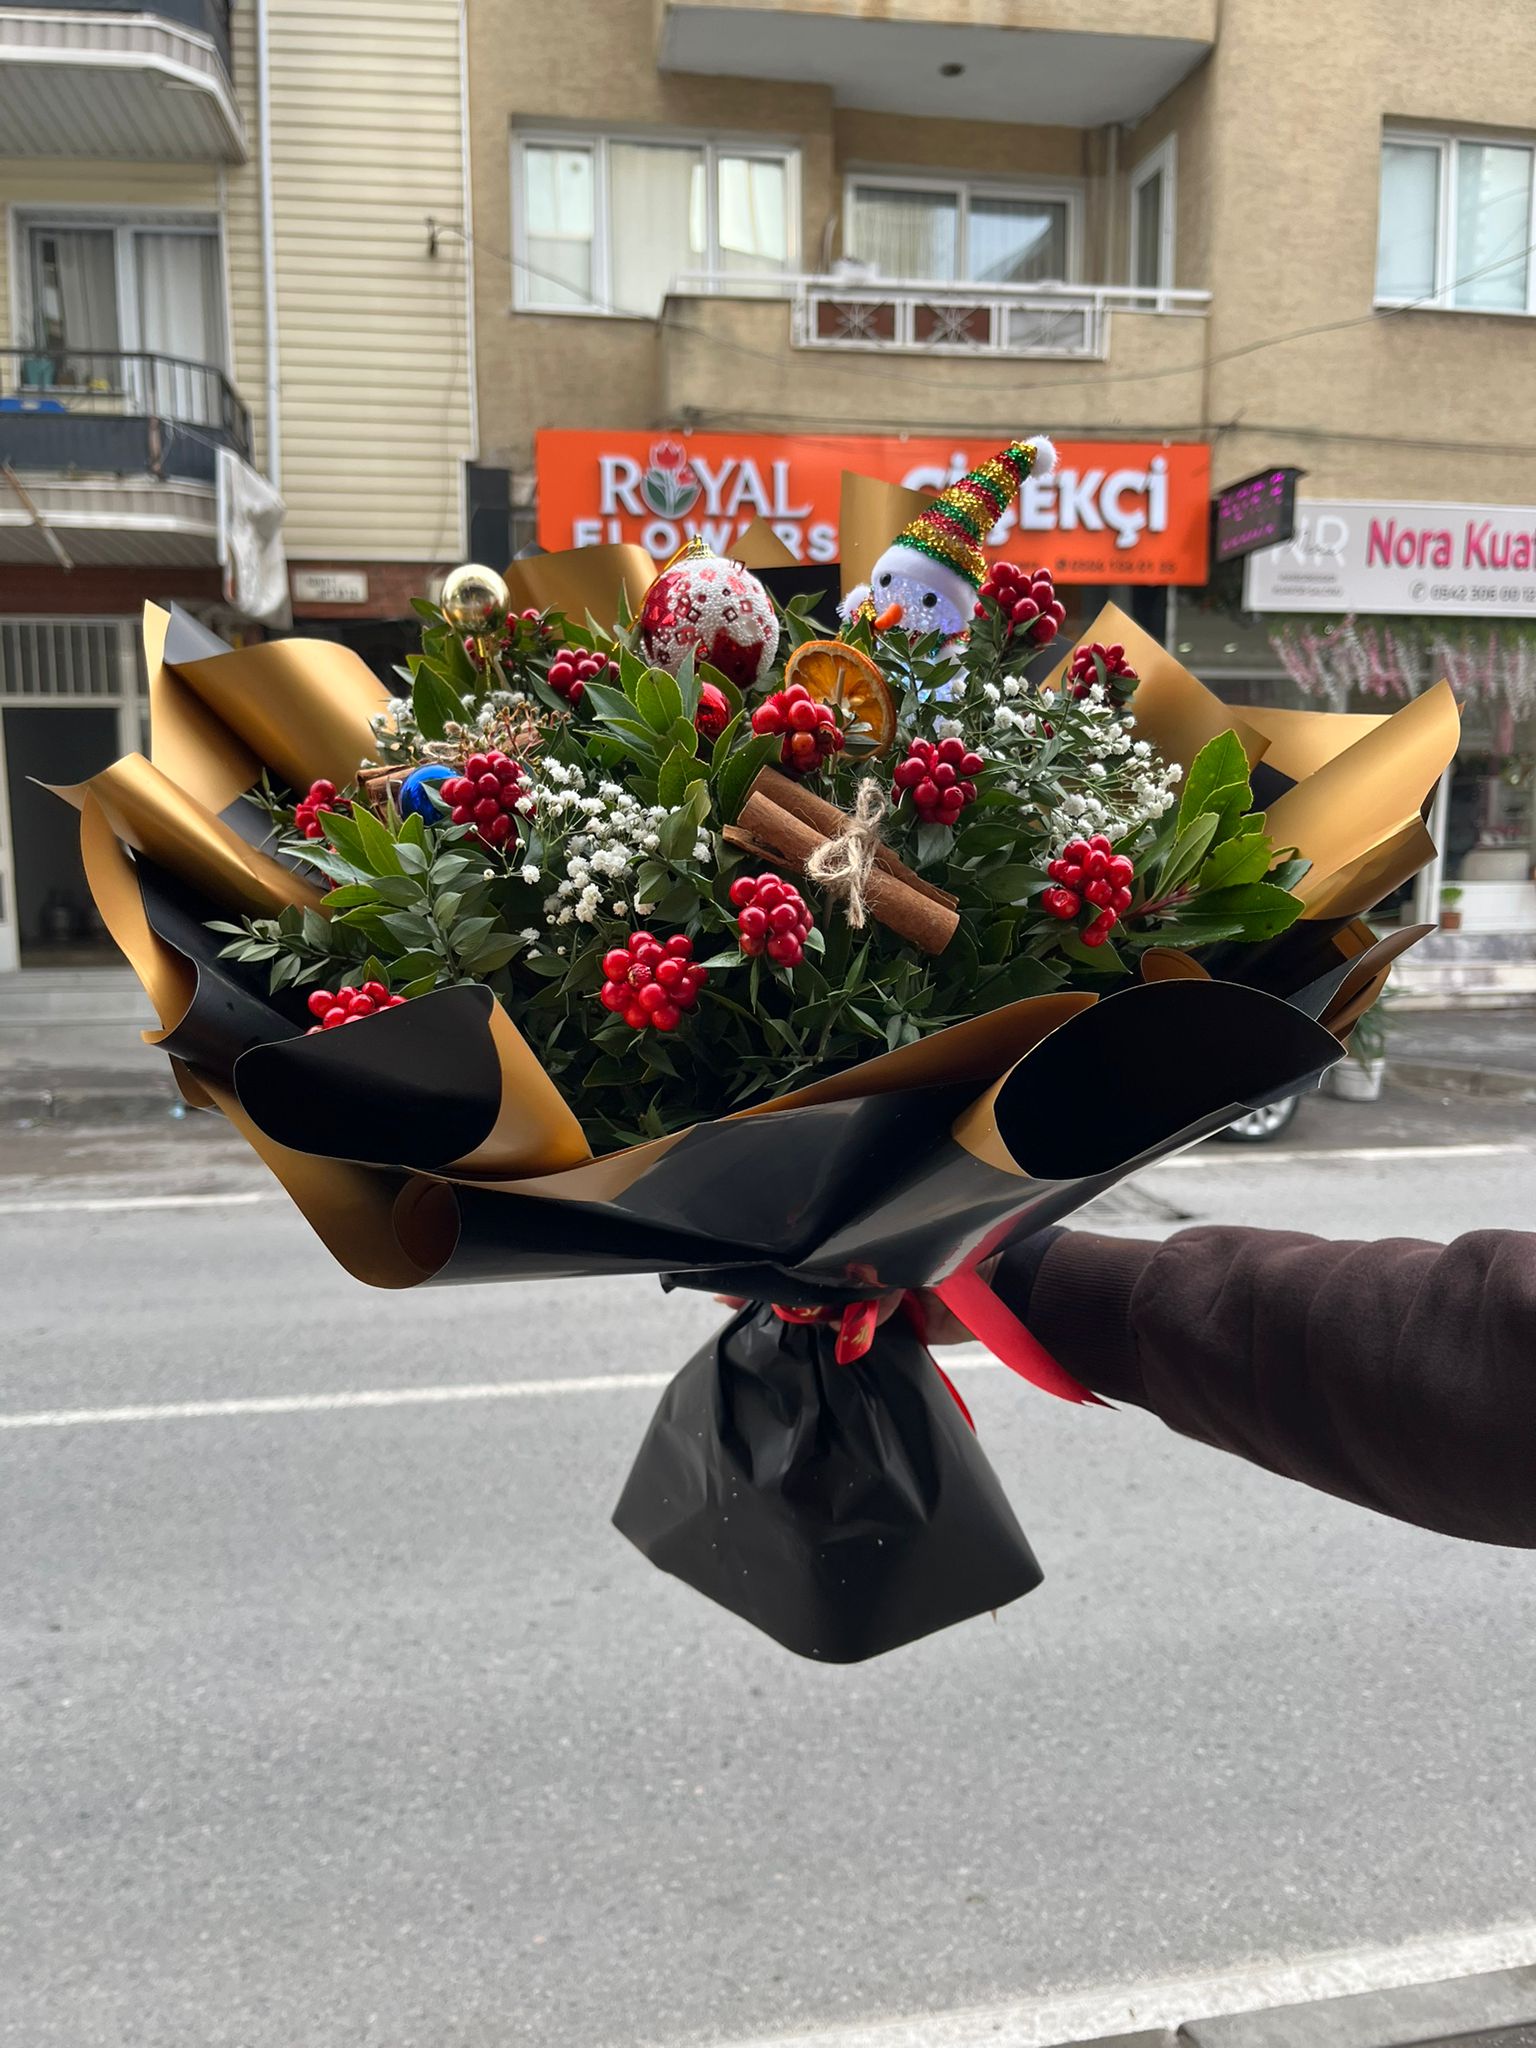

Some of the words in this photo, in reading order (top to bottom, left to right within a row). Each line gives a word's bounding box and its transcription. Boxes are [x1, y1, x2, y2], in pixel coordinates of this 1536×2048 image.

[598, 452, 815, 519] ROYAL
[1367, 517, 1450, 568] Nora
[1464, 520, 1536, 571] Kua
